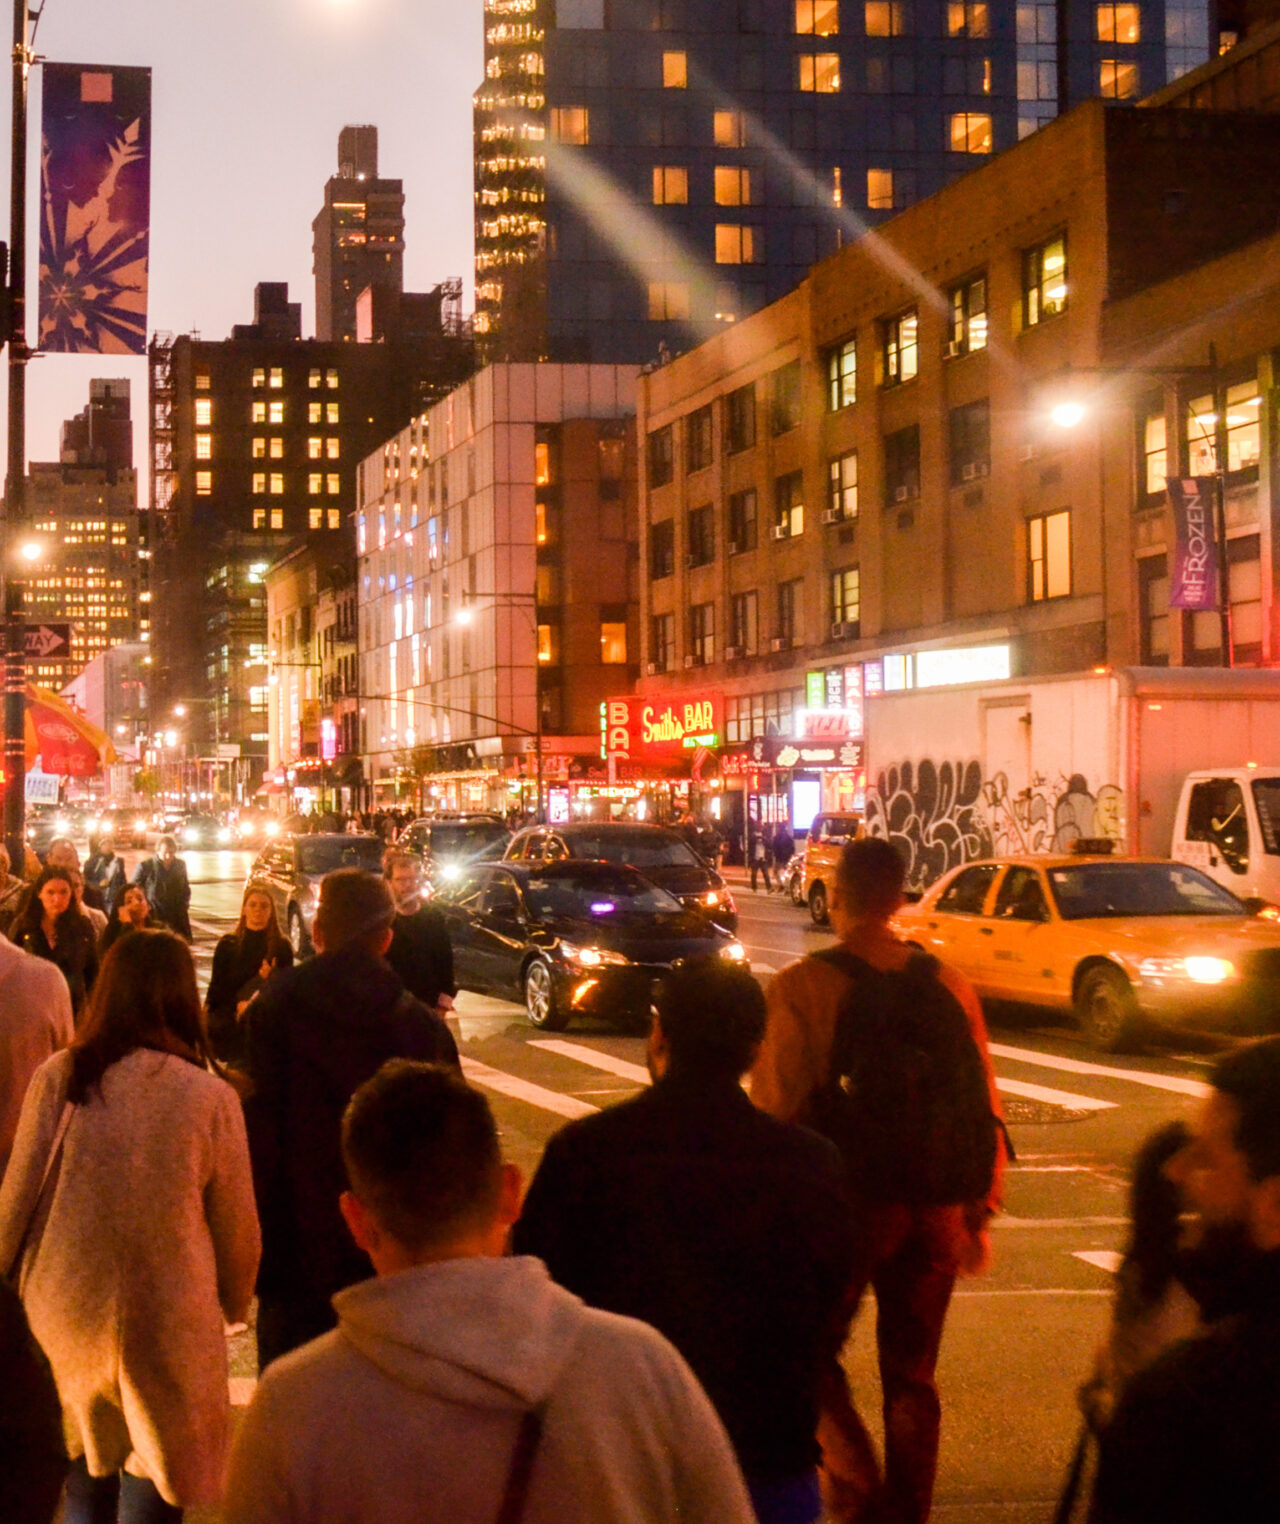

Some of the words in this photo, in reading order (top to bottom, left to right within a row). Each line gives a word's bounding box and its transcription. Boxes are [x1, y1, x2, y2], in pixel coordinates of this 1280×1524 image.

[1182, 494, 1209, 584] FROZEN
[642, 706, 685, 744] Smith's
[684, 701, 713, 733] BAR
